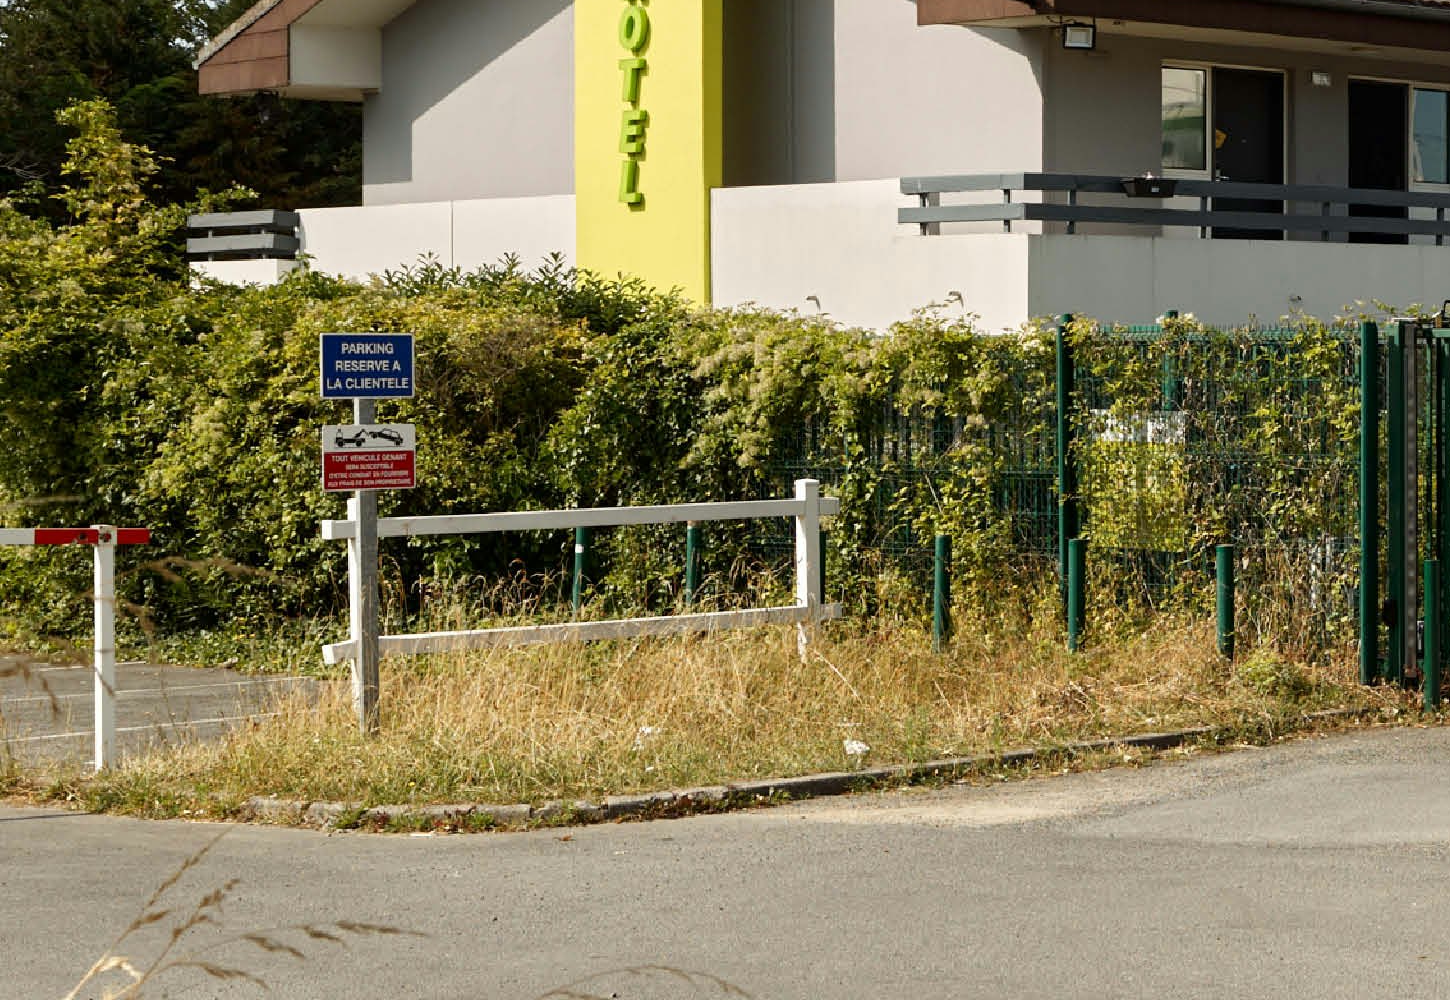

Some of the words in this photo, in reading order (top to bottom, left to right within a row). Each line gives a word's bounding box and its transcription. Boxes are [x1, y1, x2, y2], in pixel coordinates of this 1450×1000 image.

[341, 343, 394, 354] PARKING
[335, 360, 391, 371] RESERVE
[392, 360, 401, 371] A
[326, 378, 343, 389] LA
[345, 377, 409, 389] CLIENTELE
[381, 453, 407, 461] GENANT
